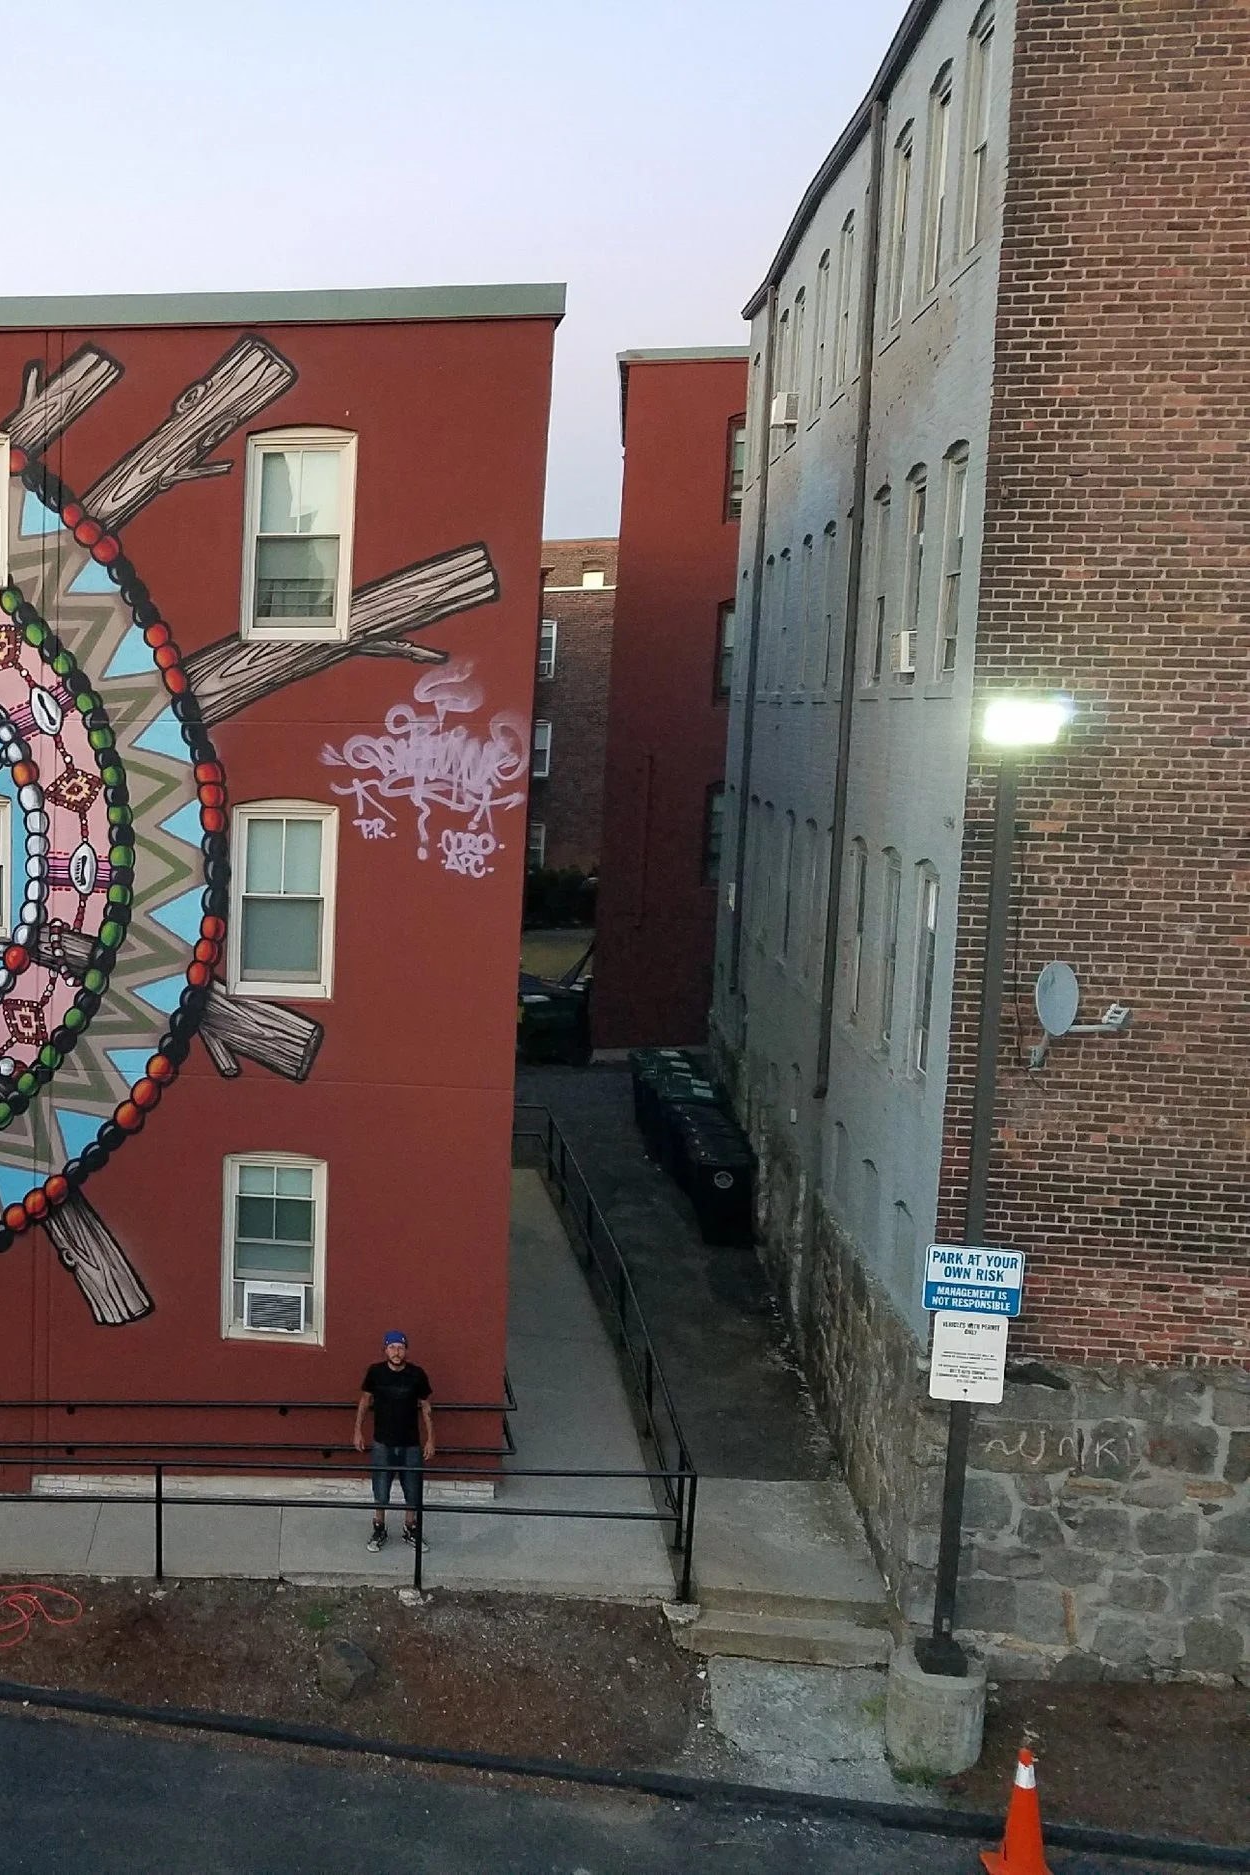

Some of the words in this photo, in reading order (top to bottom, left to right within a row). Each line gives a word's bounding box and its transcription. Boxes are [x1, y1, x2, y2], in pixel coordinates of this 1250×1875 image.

[932, 1250, 963, 1265] PARK
[967, 1254, 982, 1266] AT
[986, 1255, 1018, 1269] YOUR
[944, 1266, 971, 1279] OWN
[976, 1268, 1004, 1282] RISK
[937, 1285, 995, 1300] MANAGEMENT
[998, 1290, 1007, 1300] IS
[932, 1296, 950, 1306] NOT
[951, 1298, 1011, 1312] RESPONSIBLE
